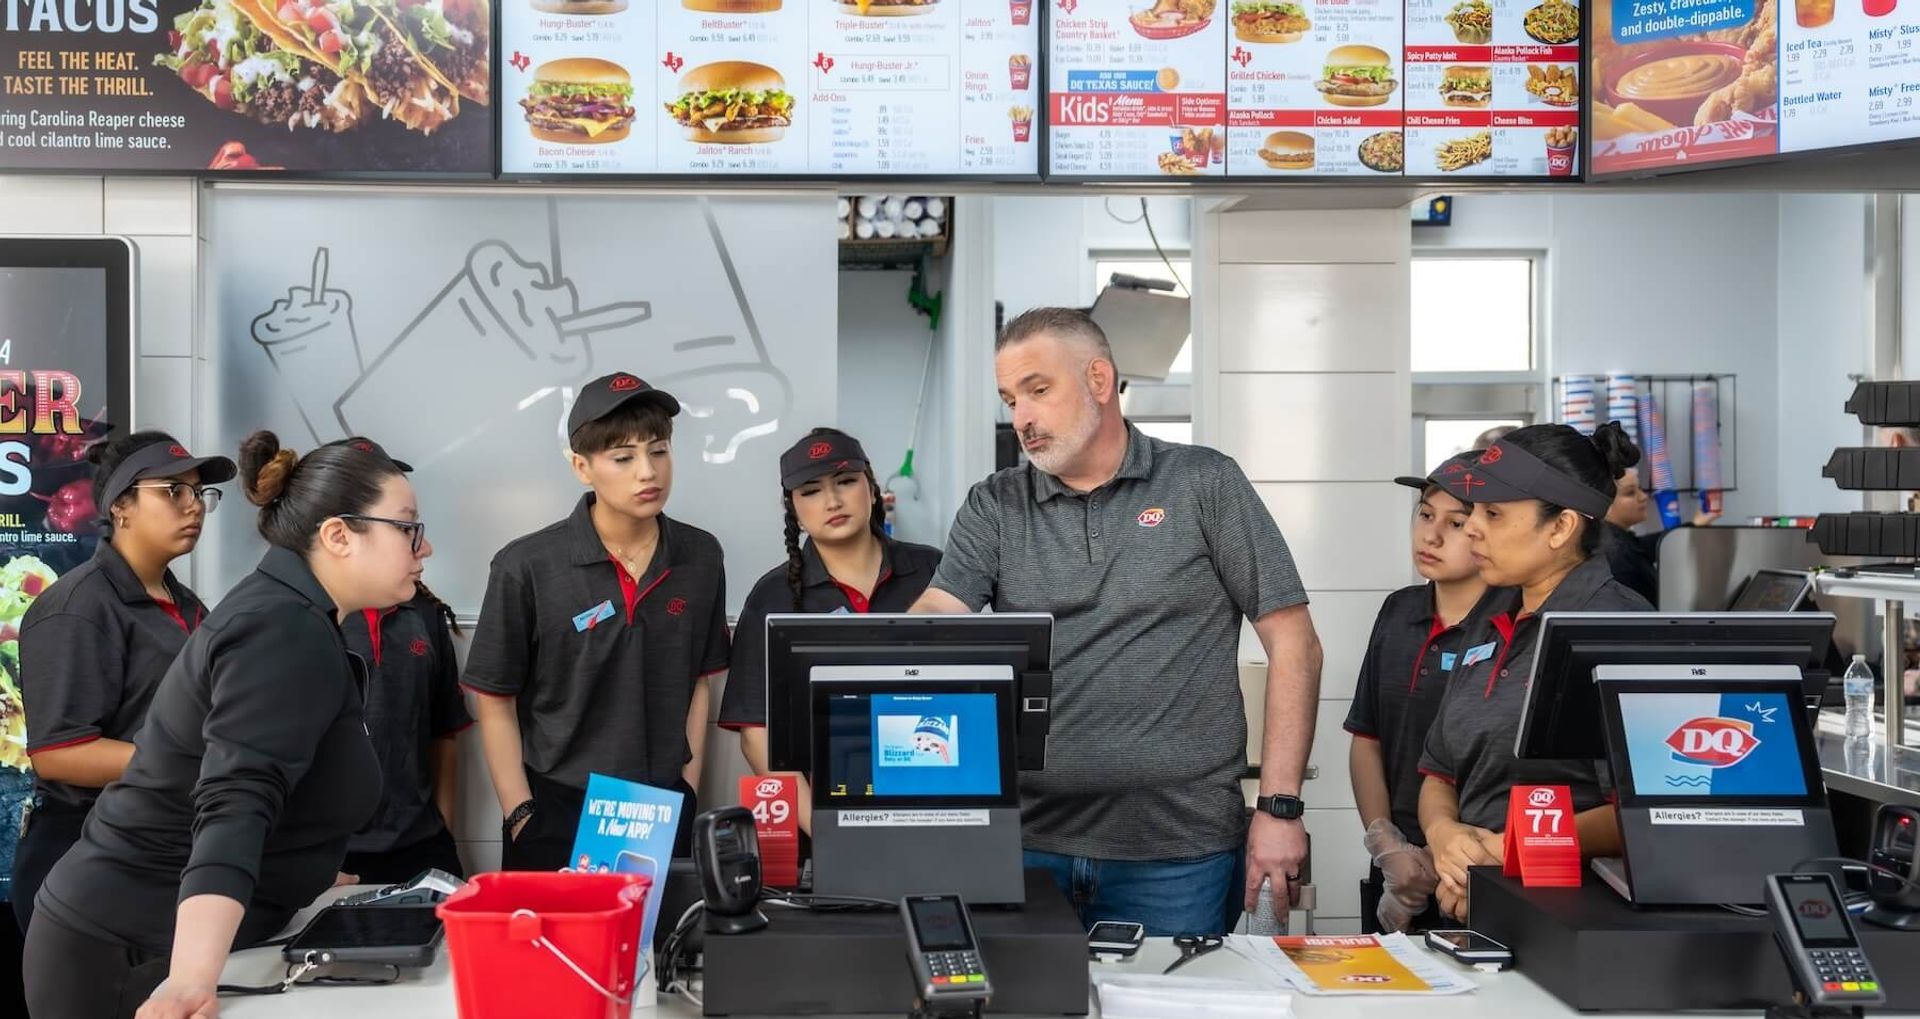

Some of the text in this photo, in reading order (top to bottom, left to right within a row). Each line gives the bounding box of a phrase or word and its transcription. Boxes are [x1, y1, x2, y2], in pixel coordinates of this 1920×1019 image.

[1633, 2, 1667, 17] Zesty,
[1056, 18, 1108, 31] Chicken Strip
[1621, 5, 1745, 36] and double-dippable.
[1056, 30, 1088, 40] Country
[1869, 24, 1920, 41] Misty Slus
[1786, 39, 1822, 52] Iced Tea
[1840, 44, 1854, 55] 2.79
[1897, 39, 1912, 49] 1.99
[1407, 52, 1424, 61] Spicy
[1424, 51, 1442, 61] Patty
[1494, 46, 1553, 55] Alaska Pollock Fish
[19, 51, 138, 71] FEEL THE HEAT.
[822, 58, 829, 69] 6
[1239, 53, 1249, 63] 11
[1230, 71, 1286, 80] Grilled Chicken
[4, 76, 153, 96] TASTE THE THRILL.
[965, 81, 987, 93] Rings
[1085, 79, 1118, 90] TEXAS
[1120, 78, 1154, 91] SAUCE!
[1869, 82, 1920, 98] Misty Free
[1113, 94, 1144, 106] Menu
[1182, 97, 1195, 105] Side
[1783, 91, 1842, 107] Bottled Water
[1896, 97, 1912, 108] 2.99
[1060, 95, 1112, 123] Kids'
[1229, 111, 1275, 119] Alaska Pollock
[0, 109, 185, 130] ring Carolina Reaper cheese
[1317, 116, 1361, 125] Chicken Salad
[1407, 116, 1460, 125] Chili Cheese Fries
[1494, 116, 1533, 125] Cheese Bites
[8, 131, 36, 147] cool
[41, 131, 91, 148] cilantro
[95, 132, 123, 148] lime
[128, 136, 171, 149] sauce.
[965, 135, 985, 144] Fries
[538, 147, 564, 156] Bacon
[566, 147, 596, 156] Cheese
[728, 146, 753, 155] Ranch
[0, 369, 84, 435] ER
[0, 441, 32, 496] S
[0, 513, 26, 527] RILL.
[0, 531, 77, 542] ntro lime sauce.
[1682, 728, 1744, 755] DQ
[884, 749, 914, 757] Blizzard
[588, 799, 672, 823] WE'RE MOVING TO
[752, 799, 790, 824] 49
[1654, 811, 1702, 822] Allergies?
[843, 812, 889, 823] Allergies?
[1524, 809, 1563, 833] 77
[597, 818, 655, 840] A New APP!
[1303, 937, 1374, 946] BUILDS!
